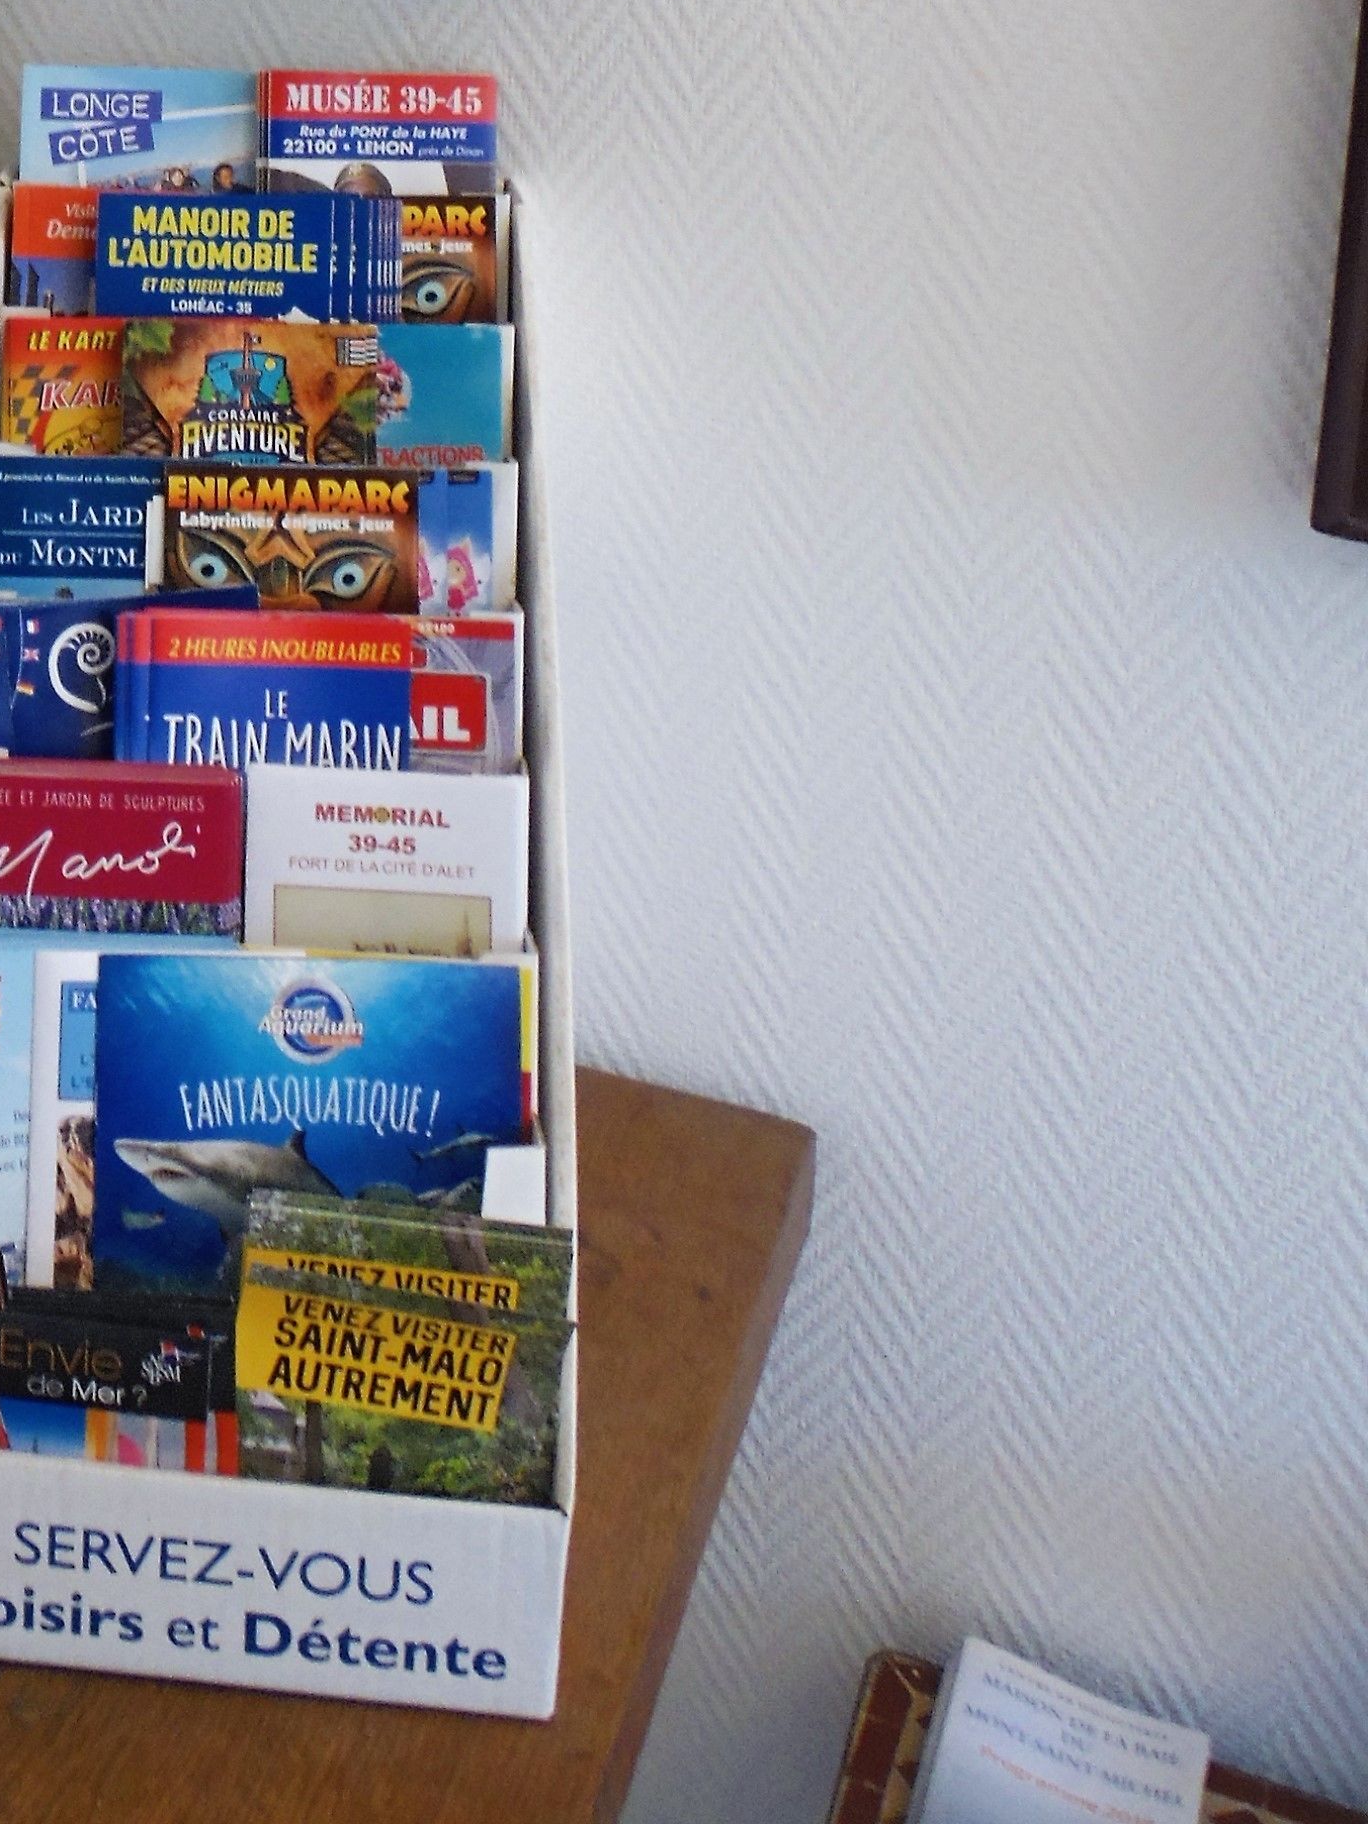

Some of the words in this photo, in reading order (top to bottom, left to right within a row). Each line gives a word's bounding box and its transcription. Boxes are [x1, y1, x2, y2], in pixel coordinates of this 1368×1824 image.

[51, 89, 151, 119] LONGE
[286, 79, 391, 114] MUSÉE
[399, 85, 483, 116] 39-45
[57, 121, 140, 161] CÔTE
[283, 138, 338, 156] 22100
[356, 140, 414, 157] LEHON
[299, 124, 327, 139] Rue
[329, 124, 347, 138] du
[350, 125, 390, 140] PONT
[392, 125, 410, 139] de
[412, 124, 428, 140] la
[431, 126, 468, 141] HAYE
[133, 204, 255, 241] MANOIR
[259, 208, 296, 242] DE
[107, 237, 319, 275] L'AUTOMOBILE
[186, 277, 226, 297] VIEUX
[208, 408, 281, 425] CORSAIRE
[182, 421, 305, 463] AVENTURE
[168, 475, 412, 514] ENIGMAPARC
[30, 537, 145, 569] MONTM
[168, 636, 182, 657] 2
[184, 637, 258, 661] HEURES
[260, 638, 402, 665] INOUBLIABLES
[263, 688, 289, 721] LE
[162, 713, 268, 769] TRAIN
[284, 721, 403, 773] MARIN
[314, 801, 451, 829] MEMORIAL
[347, 832, 417, 856] 39-45
[288, 854, 330, 872] FORT
[334, 857, 357, 873] DE
[360, 859, 379, 874] LA
[393, 1270, 512, 1308] VISITER
[283, 1294, 383, 1333] VENEZ
[391, 1314, 510, 1356] VISITER
[0, 1326, 123, 1381] Envie
[273, 1316, 506, 1388] SAINT-MALO
[26, 1375, 65, 1398] de
[71, 1377, 126, 1406] Mer
[266, 1354, 496, 1426] AUTREMENT
[13, 1520, 436, 1607] SERVEZ-VOUS
[166, 1616, 221, 1654] et
[242, 1610, 509, 1682] Détente
